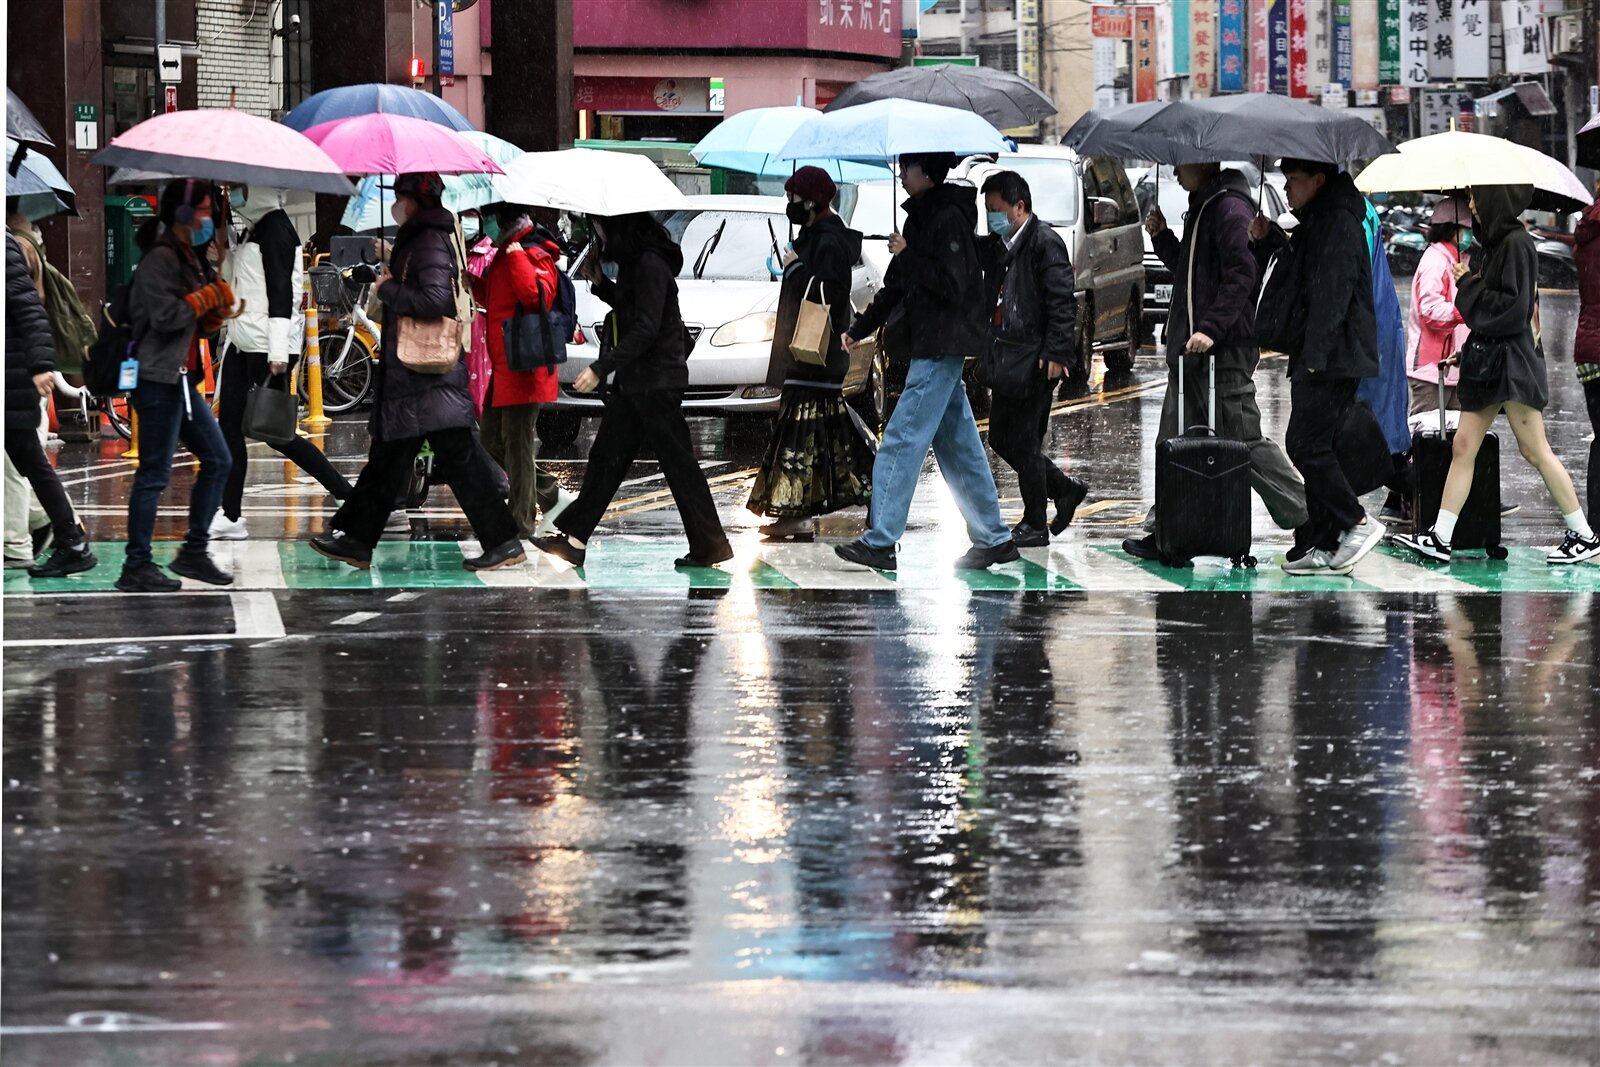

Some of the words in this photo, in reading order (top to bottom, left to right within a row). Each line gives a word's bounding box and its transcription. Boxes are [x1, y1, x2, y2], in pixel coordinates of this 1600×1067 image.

[439, 1, 447, 34] P
[1194, 0, 1210, 88] 批發零售
[1408, 0, 1428, 83] 修中心
[1434, 0, 1453, 60] 黑輪
[656, 96, 682, 109] Carol
